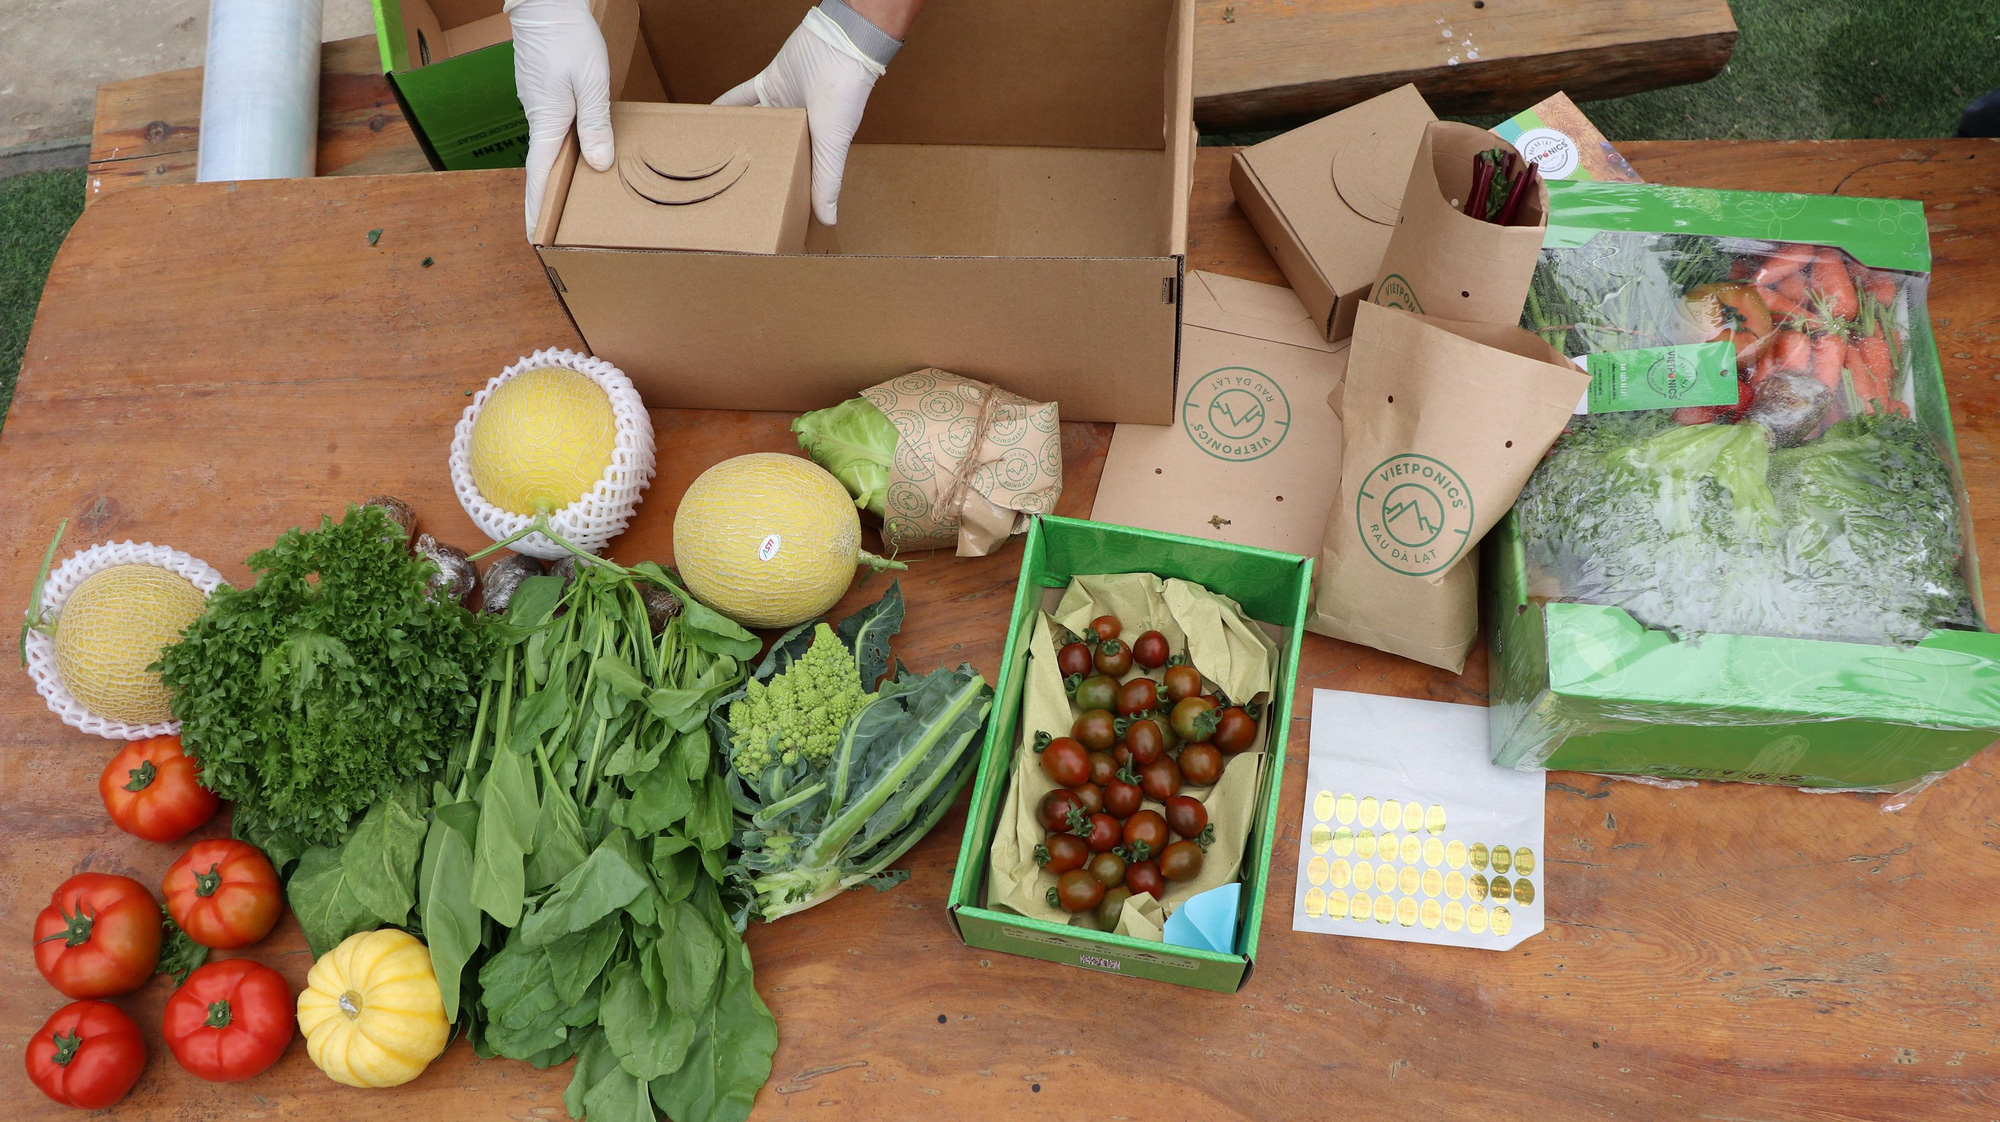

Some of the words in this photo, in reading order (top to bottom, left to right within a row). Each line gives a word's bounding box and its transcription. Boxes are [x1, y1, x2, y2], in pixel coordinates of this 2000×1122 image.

[502, 119, 528, 131] DUCE
[1528, 141, 1568, 165] ETPONICS
[1385, 283, 1416, 312] VIETPON
[1211, 376, 1231, 391] LẠT
[1667, 350, 1677, 400] VIETPONICS
[1254, 383, 1275, 403] RAU
[993, 427, 1024, 444] VIETPONICS
[1193, 423, 1272, 455] VIETPONICS
[1005, 471, 1034, 489] VIETPONICS
[1380, 463, 1463, 508] VIETPONICS
[762, 538, 775, 559] ASTI
[1370, 523, 1390, 550] RAU
[1391, 548, 1409, 563] ĐÀ
[1414, 549, 1437, 564] LẠT
